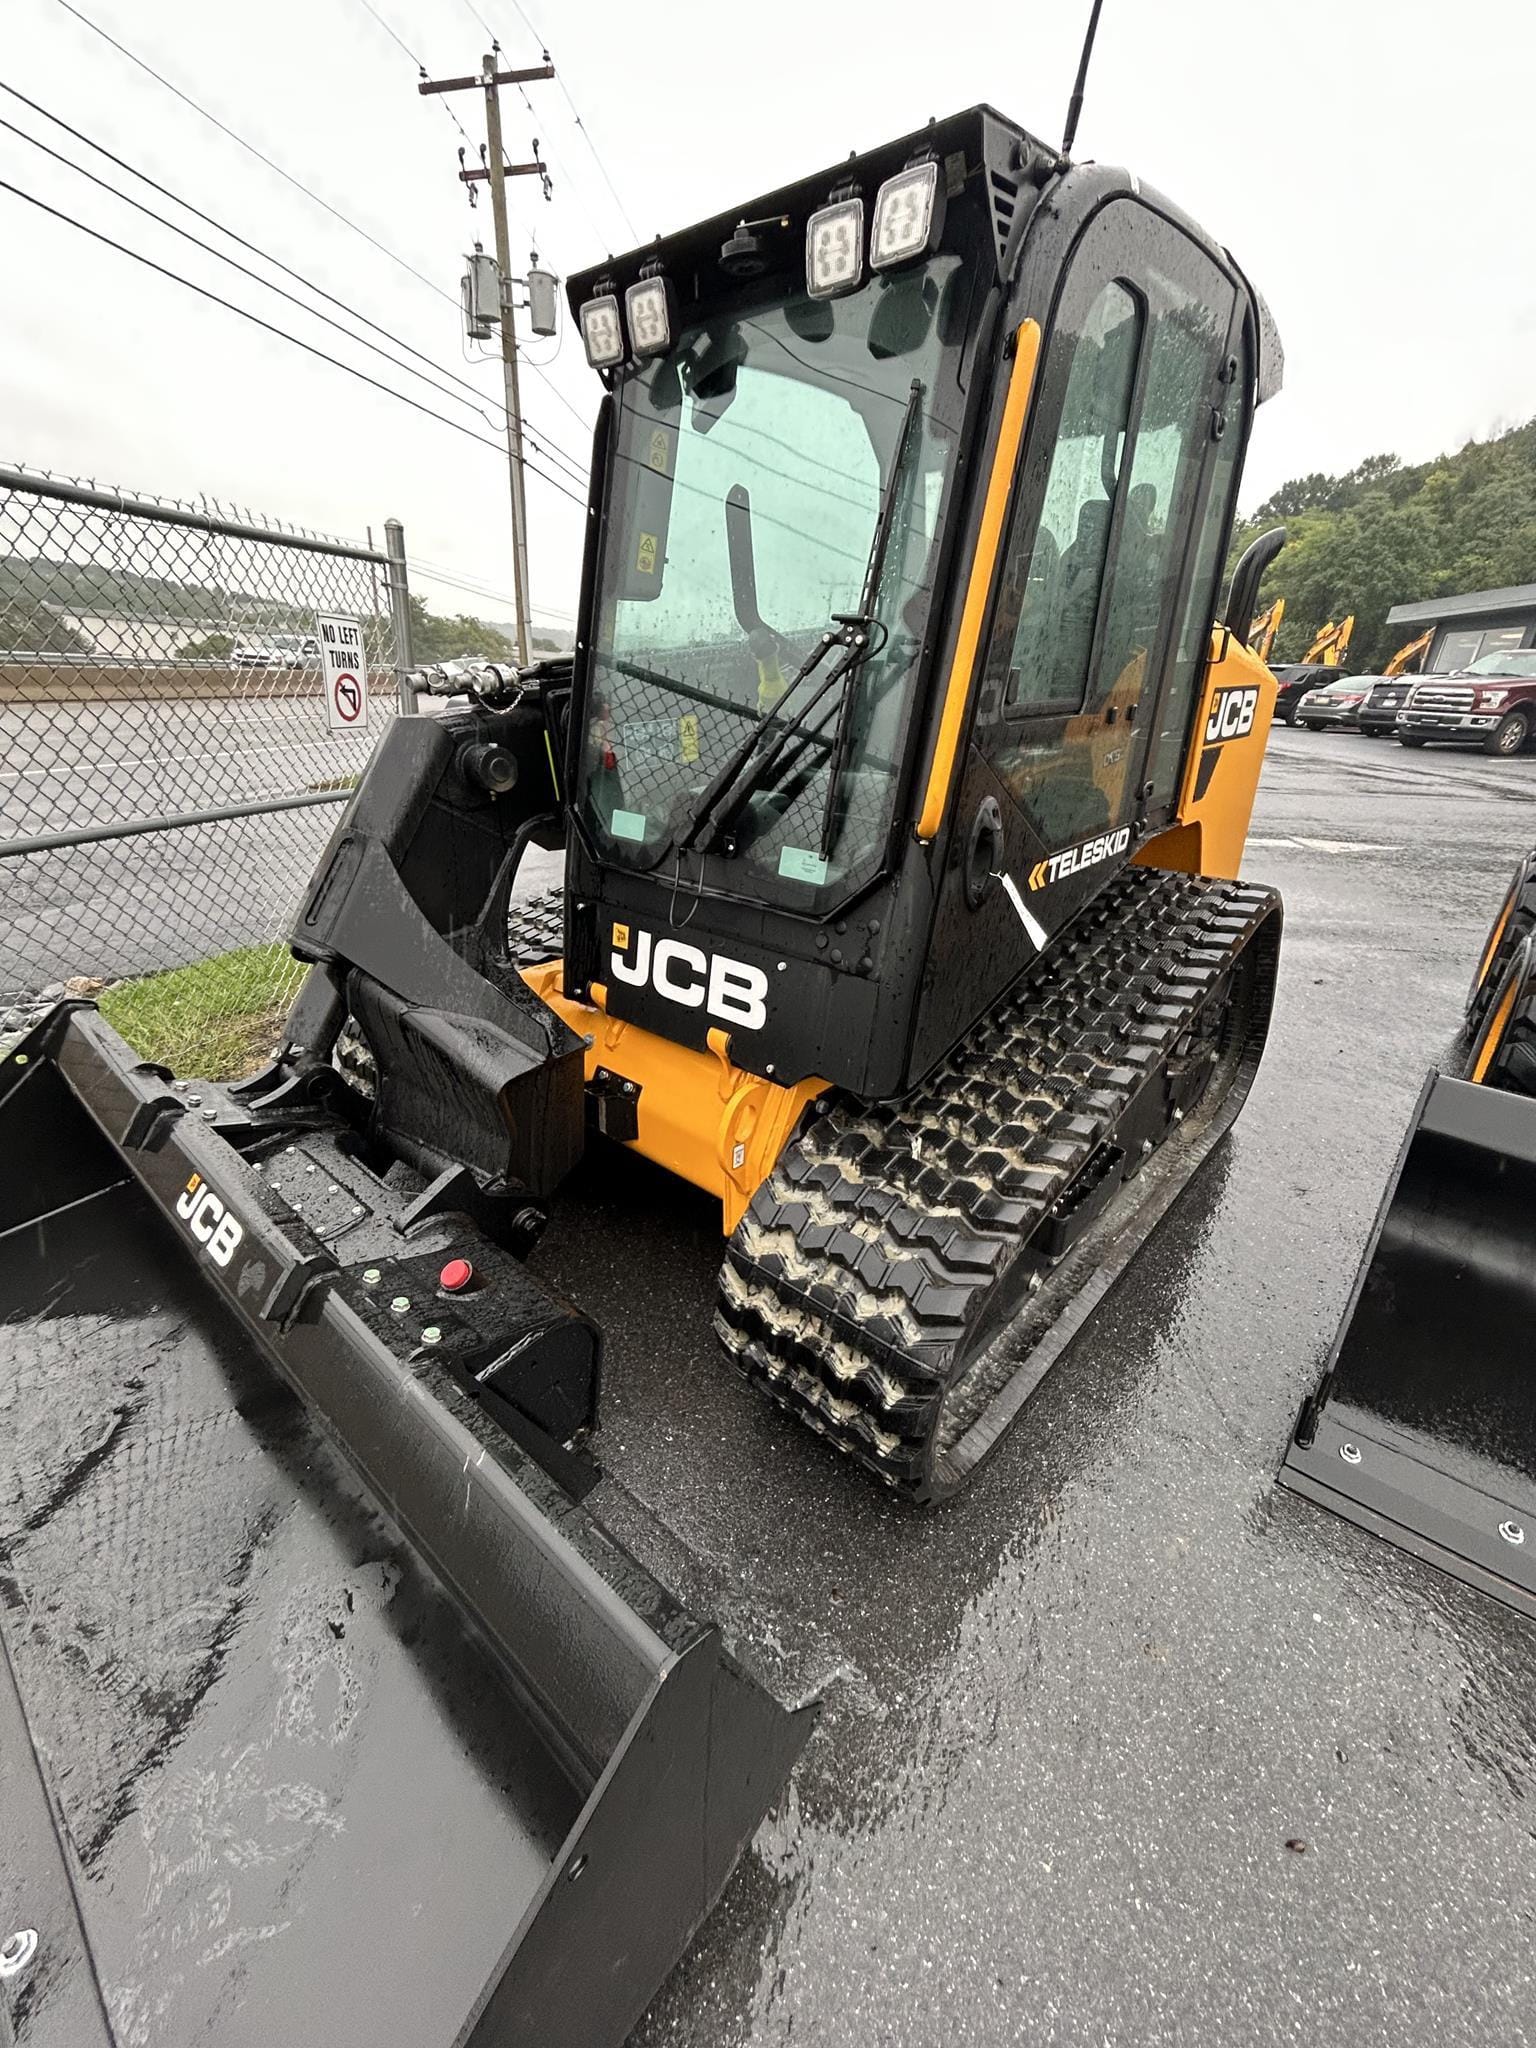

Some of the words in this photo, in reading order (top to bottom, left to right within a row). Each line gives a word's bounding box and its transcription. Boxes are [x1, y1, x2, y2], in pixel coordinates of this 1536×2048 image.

[321, 623, 335, 642] NO
[337, 625, 359, 646] LEFT
[329, 650, 360, 669] TURNS
[1206, 690, 1257, 740] JCB
[1048, 827, 1130, 883] TELESKID
[611, 930, 768, 1030] JCB
[177, 1183, 243, 1267] JCB
